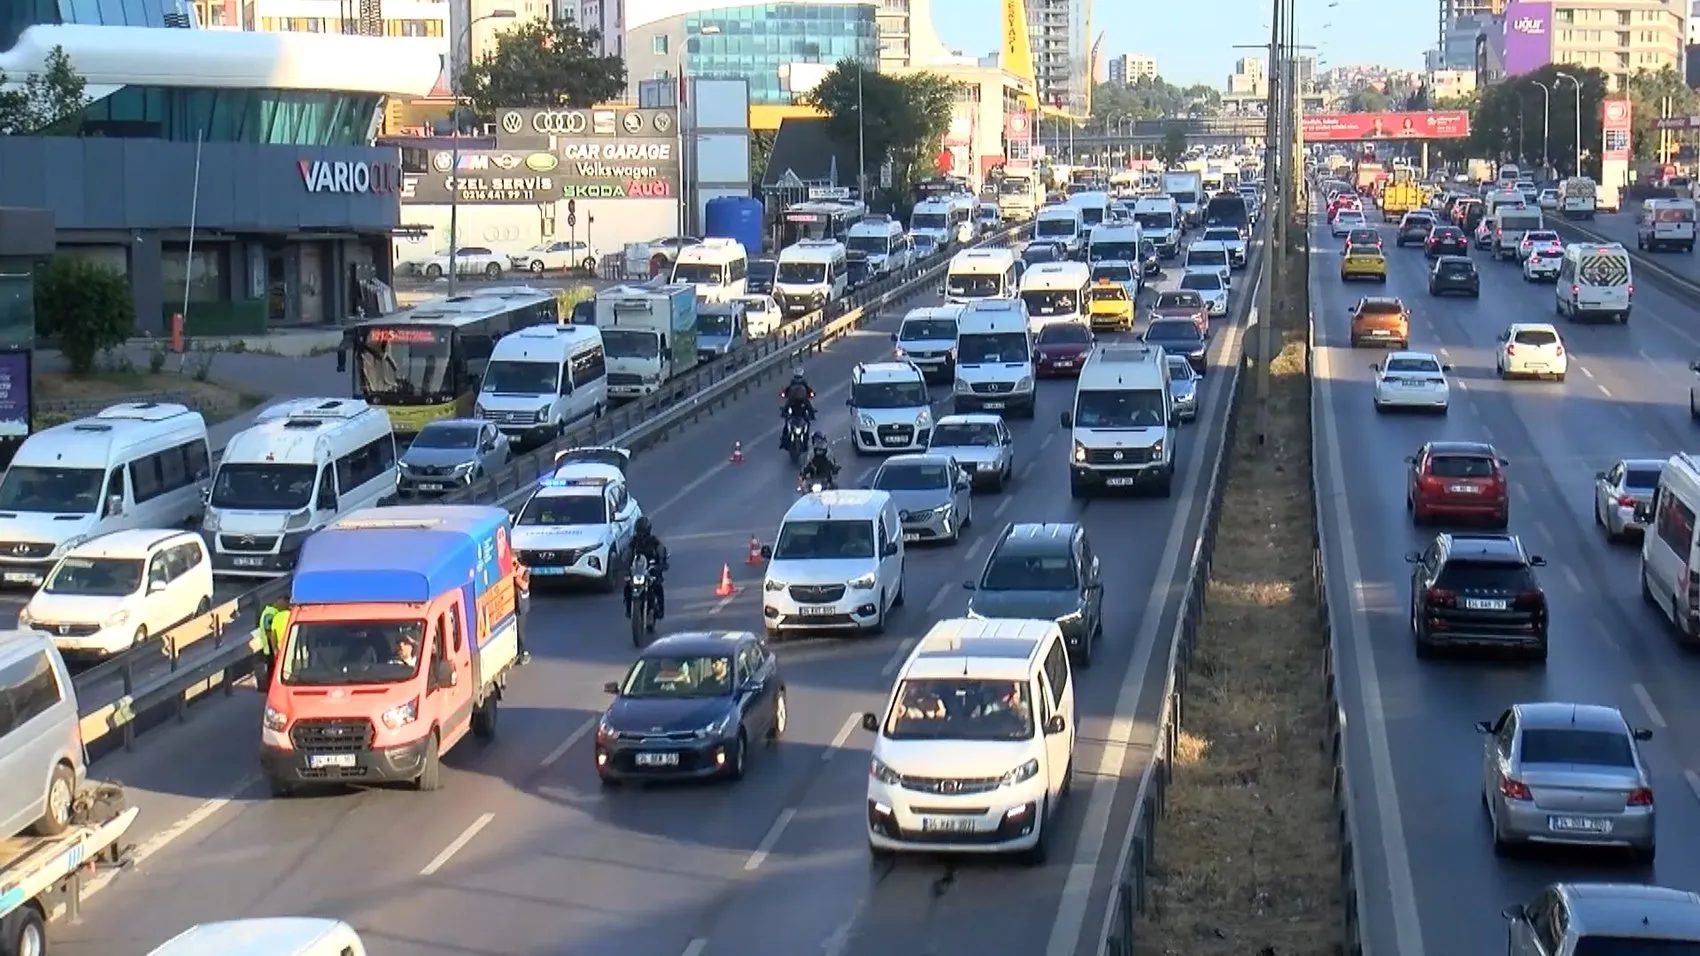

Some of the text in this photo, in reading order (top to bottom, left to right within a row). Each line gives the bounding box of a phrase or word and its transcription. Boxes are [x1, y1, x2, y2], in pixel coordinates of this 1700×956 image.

[1513, 16, 1543, 32] uğur
[565, 144, 670, 160] CAR GARAGE
[577, 162, 657, 179] Volkswagen
[492, 175, 552, 190] SERVİS
[625, 180, 670, 197] Audi
[462, 190, 533, 199] 0216 441 99 11
